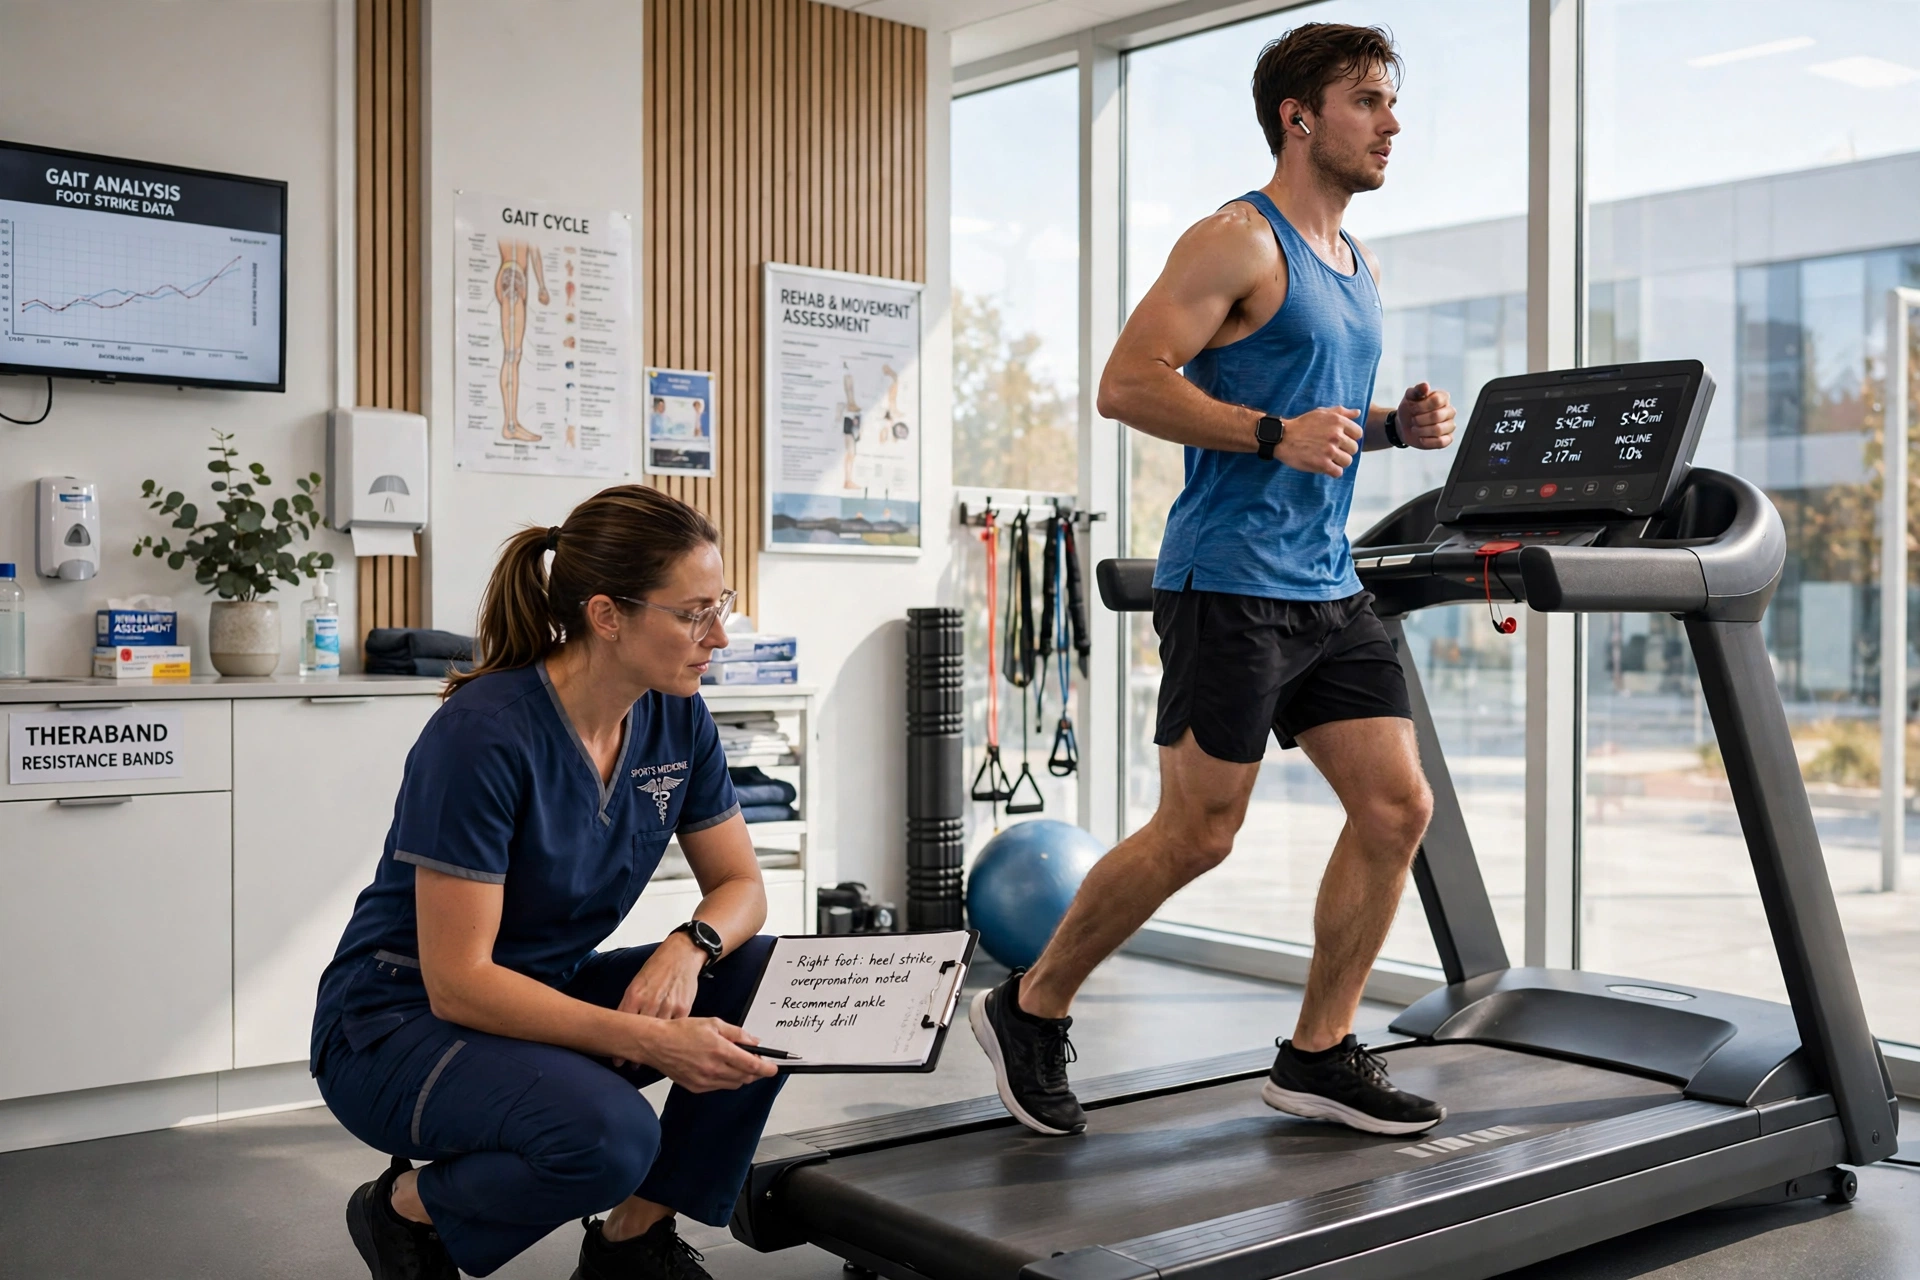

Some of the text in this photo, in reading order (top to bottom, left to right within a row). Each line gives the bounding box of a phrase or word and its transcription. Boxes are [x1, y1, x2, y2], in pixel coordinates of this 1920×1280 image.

[45, 168, 181, 201] GAIT ANALYSIS
[55, 189, 175, 217] FOOT STRIKE DATA
[502, 207, 590, 235] GAIT CYCLE
[780, 288, 911, 320] REHAB & MOVEMENT
[783, 308, 870, 334] ASSESSMENT
[1503, 403, 1590, 418] TIME PACE
[1632, 398, 1658, 409] PACE
[1494, 420, 1527, 434] 12:34
[1489, 433, 1653, 452] PAST DIST INCLINE
[1619, 446, 1643, 460] 1.0%
[25, 723, 168, 746] THERABAND
[22, 751, 174, 770] RESISTANCE BANDS
[796, 954, 830, 972] Right
[834, 953, 864, 967] foot:
[868, 952, 895, 966] heel
[790, 970, 911, 990] overpronation noted
[781, 995, 848, 1009] Recommend
[853, 995, 886, 1008] ankle
[775, 1013, 858, 1032] mobility drill
